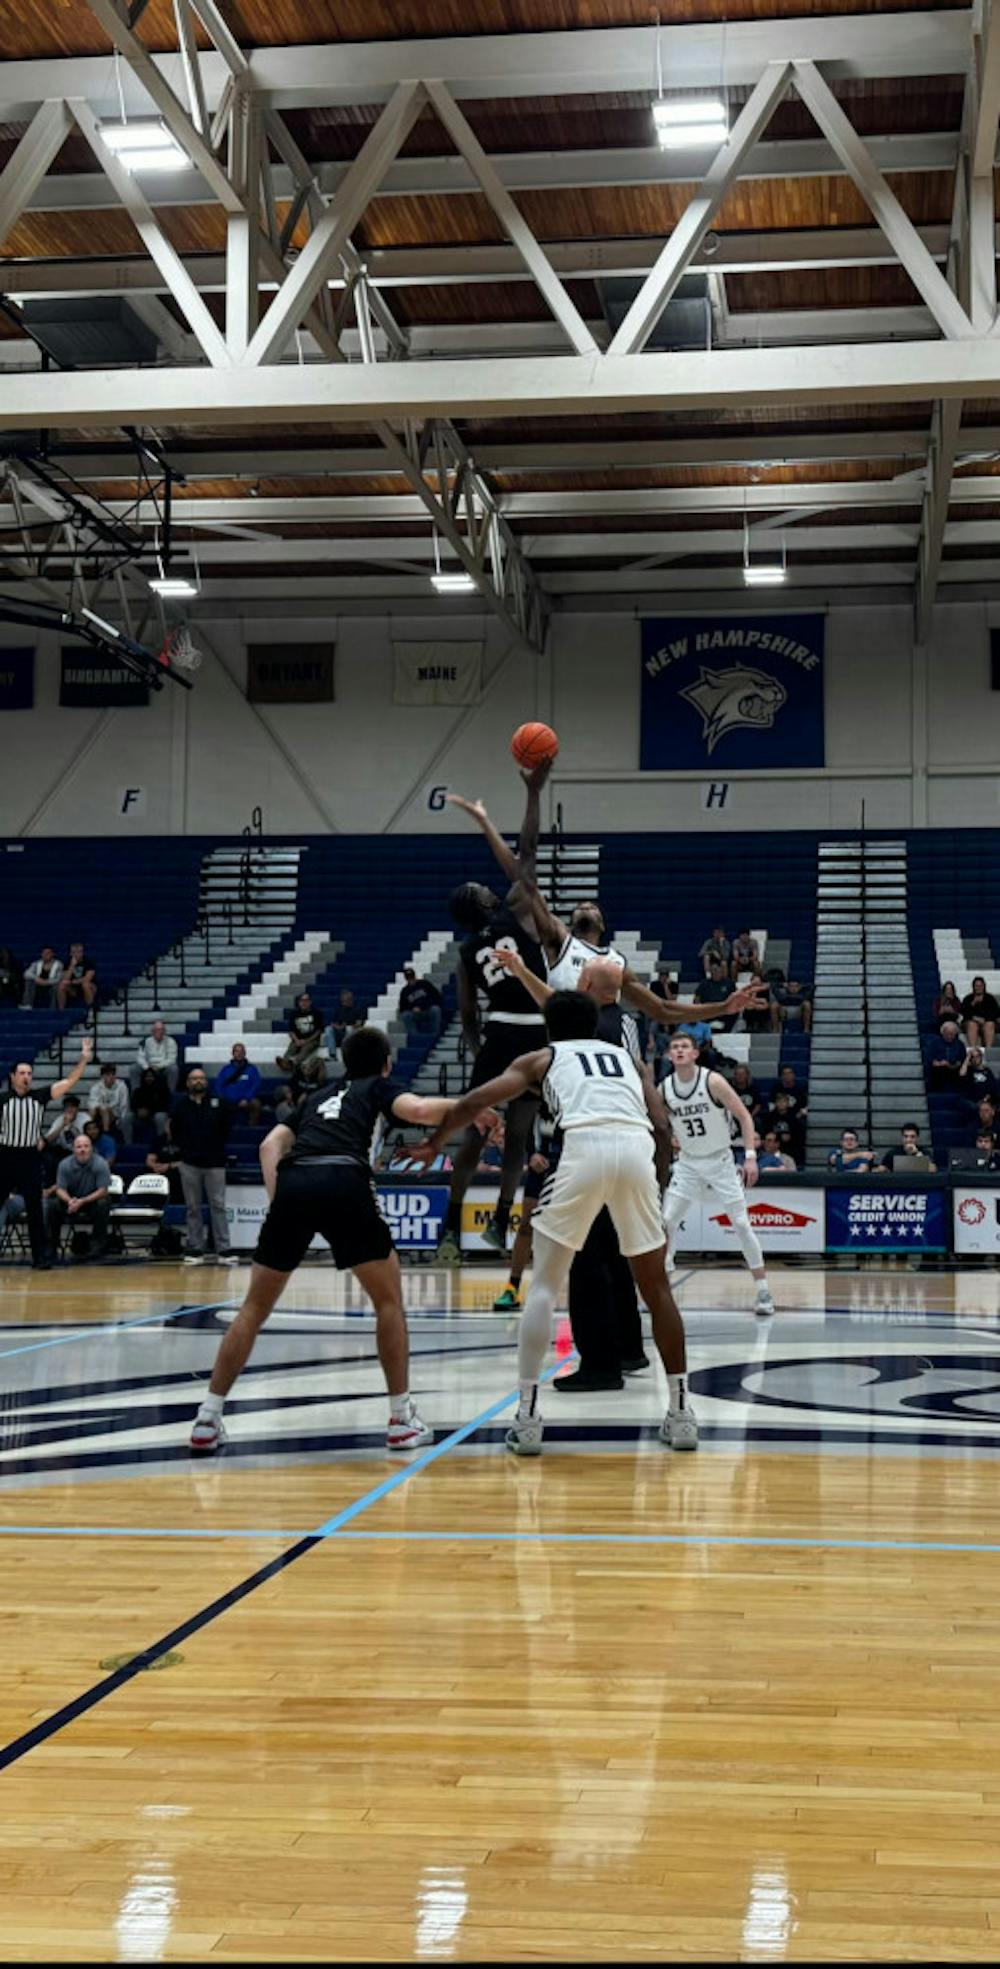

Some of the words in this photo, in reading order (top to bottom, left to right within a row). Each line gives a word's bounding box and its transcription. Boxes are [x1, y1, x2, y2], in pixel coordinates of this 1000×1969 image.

[644, 637, 689, 678] NEW
[695, 629, 821, 671] HAMPSHIRE
[416, 666, 457, 681] MAINE
[121, 789, 140, 814] F
[428, 787, 447, 810] G
[706, 783, 729, 808] H
[574, 1051, 625, 1078] 10
[317, 1079, 352, 1120] 4
[682, 1118, 707, 1137] 33
[848, 1194, 927, 1211] SERVICE
[385, 1216, 442, 1241] GHT
[748, 1213, 794, 1225] RVPRO
[848, 1212, 886, 1222] CREDIT
[887, 1212, 926, 1222] UNION
